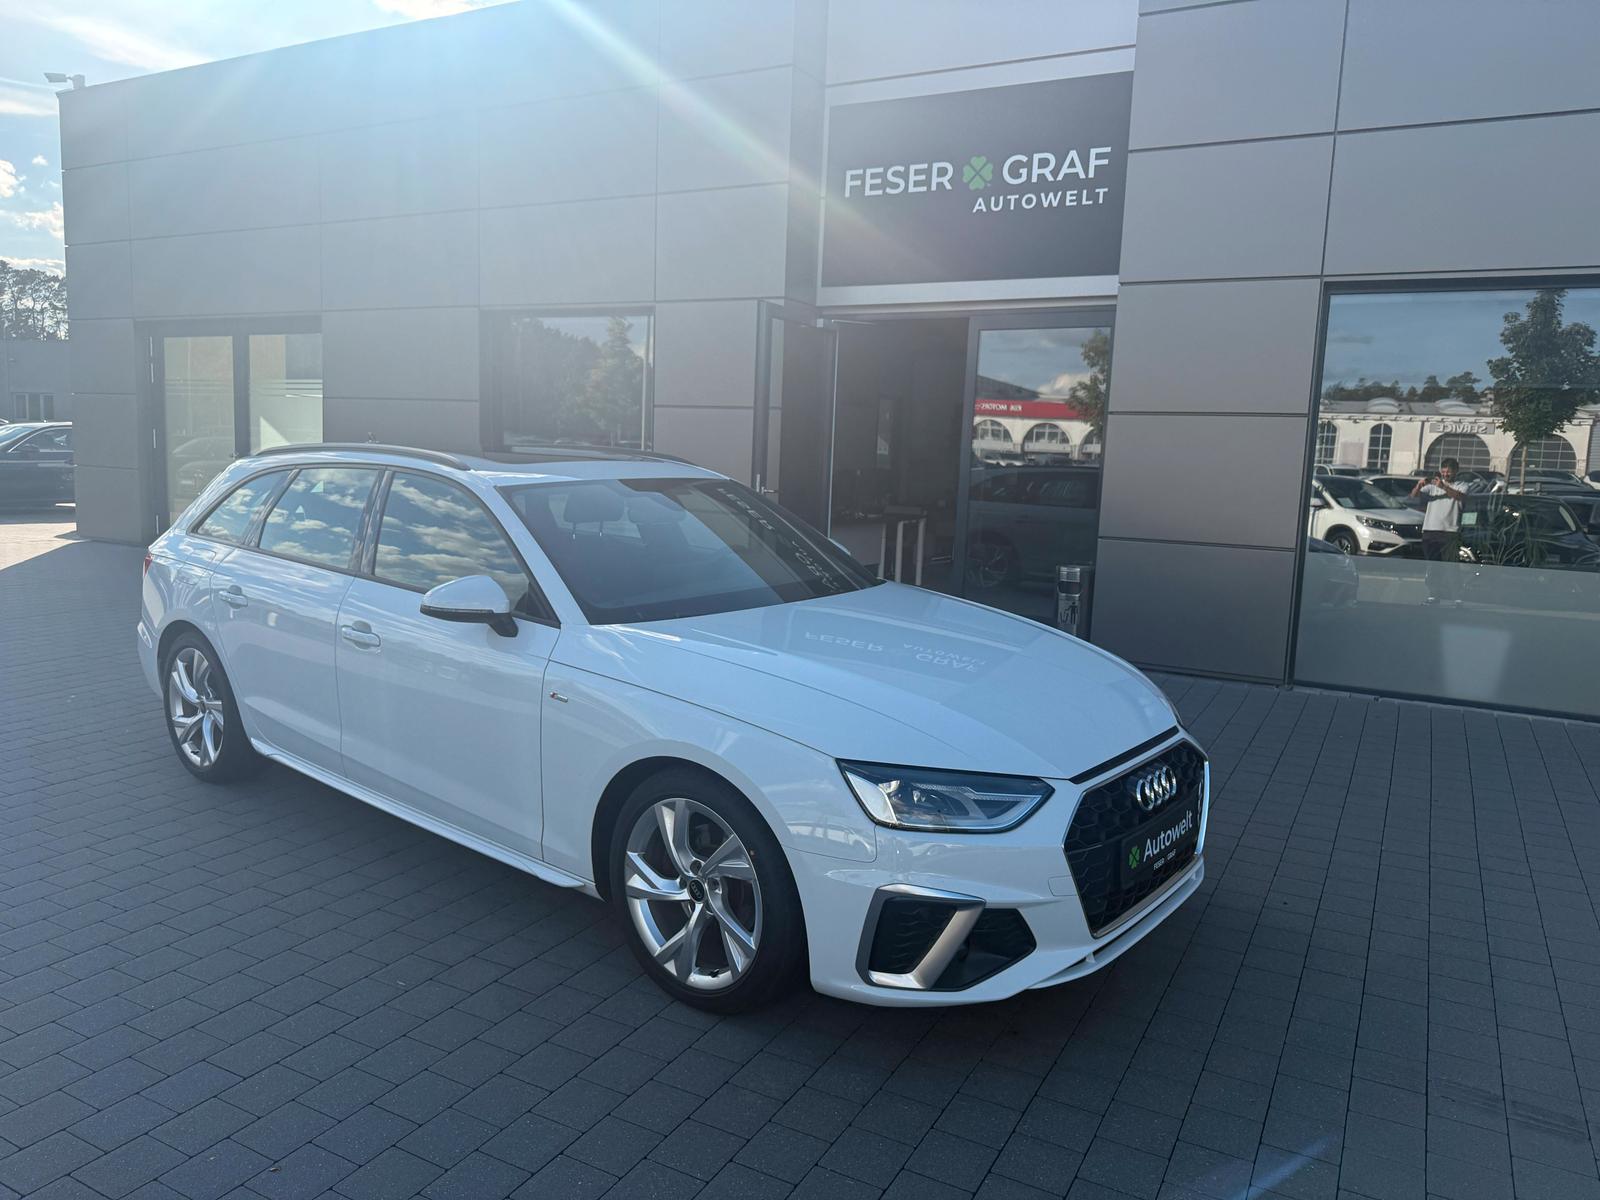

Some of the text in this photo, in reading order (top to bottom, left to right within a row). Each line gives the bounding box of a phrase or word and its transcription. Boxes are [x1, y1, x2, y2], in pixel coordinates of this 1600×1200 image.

[844, 147, 1112, 198] FESER GRAF
[972, 188, 1109, 213] AUTOWELT
[1143, 810, 1193, 863] Autowelt
